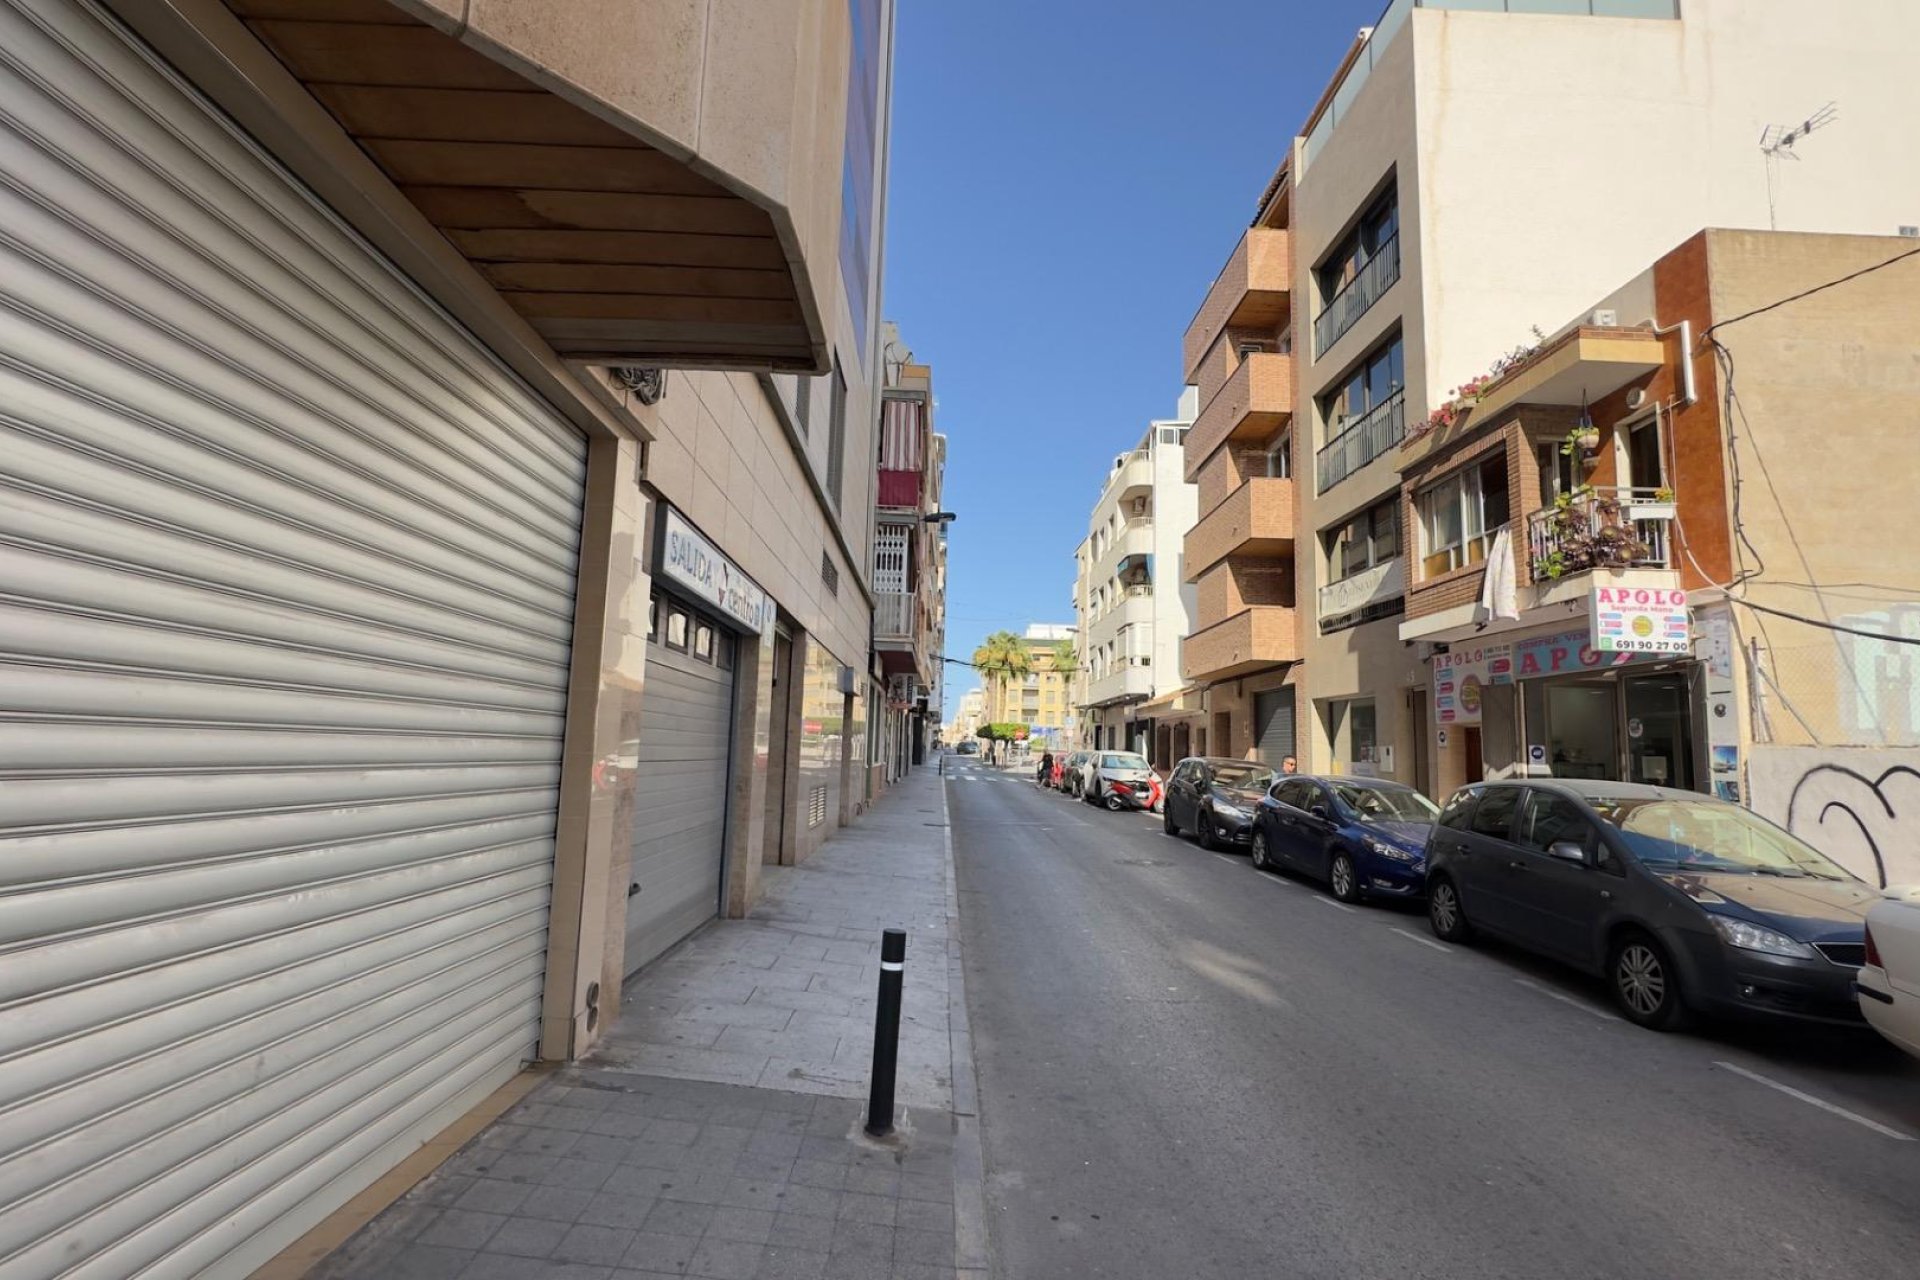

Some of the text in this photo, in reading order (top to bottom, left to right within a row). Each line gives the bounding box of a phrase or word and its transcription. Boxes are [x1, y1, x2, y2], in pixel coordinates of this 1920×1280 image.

[670, 530, 712, 587] SALIDA
[728, 588, 754, 624] centro
[1598, 587, 1686, 606] APOLO
[1610, 604, 1648, 613] Segunda
[1616, 640, 1688, 651] 691 90 27 00
[1436, 648, 1483, 669] APOLO
